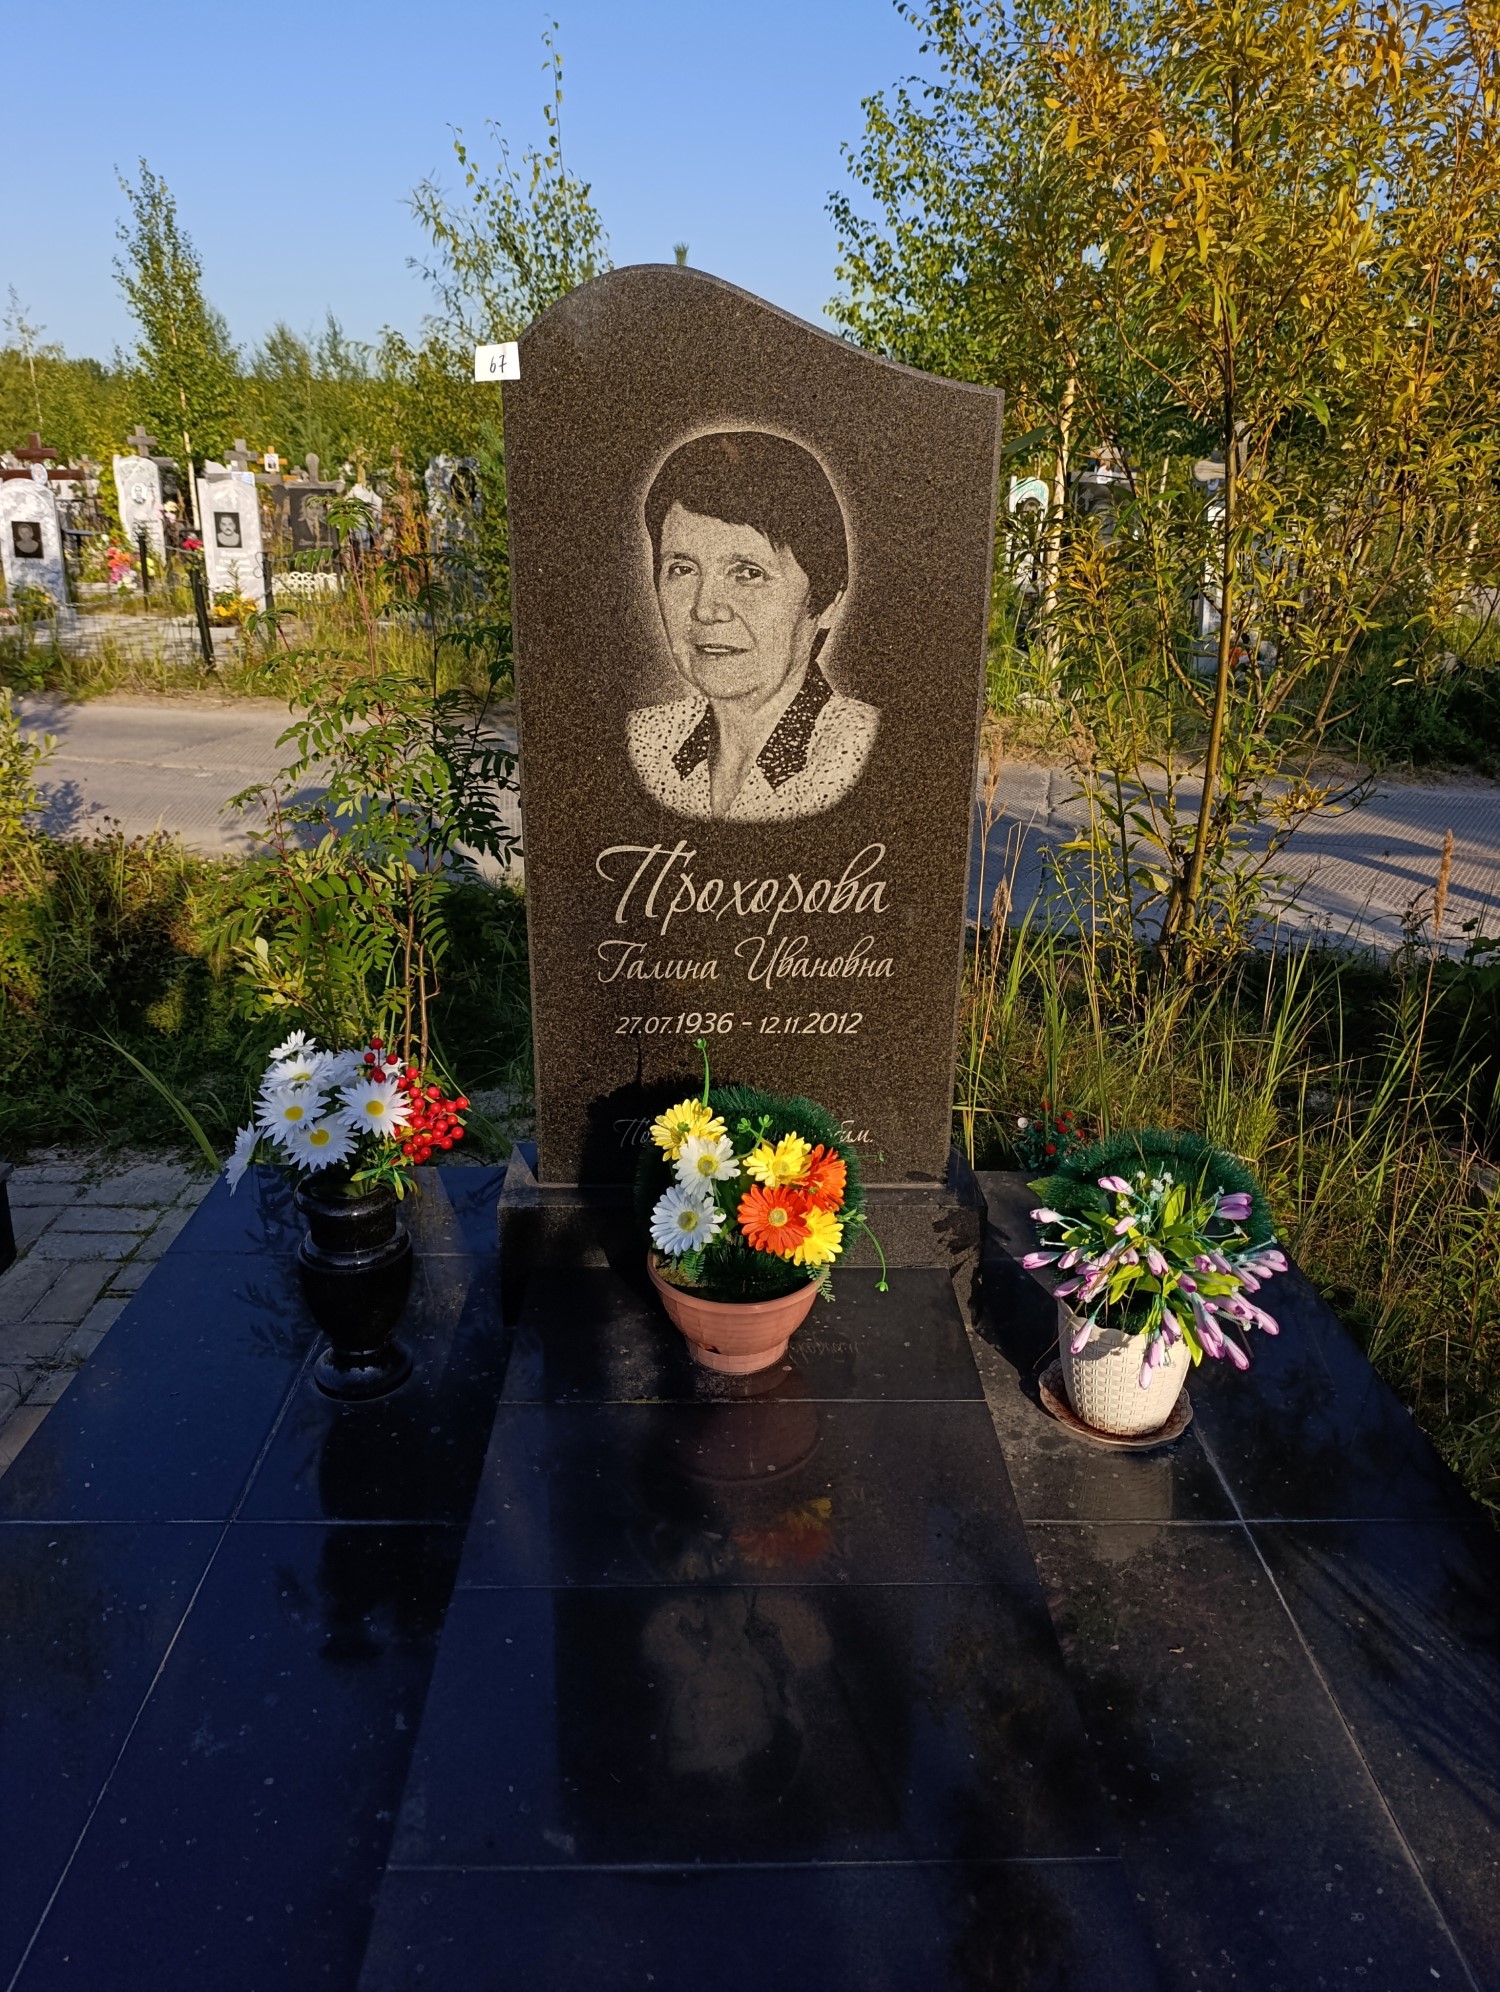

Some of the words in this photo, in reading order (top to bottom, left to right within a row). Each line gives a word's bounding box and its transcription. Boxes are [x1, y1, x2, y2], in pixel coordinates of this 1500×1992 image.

[489, 354, 507, 374] 67
[595, 839, 890, 936] Прохорова
[597, 939, 720, 983] Галина
[734, 935, 895, 989] Ивановна
[615, 1012, 734, 1034] 27.07.1936
[759, 1012, 863, 1034] 12.11.2012
